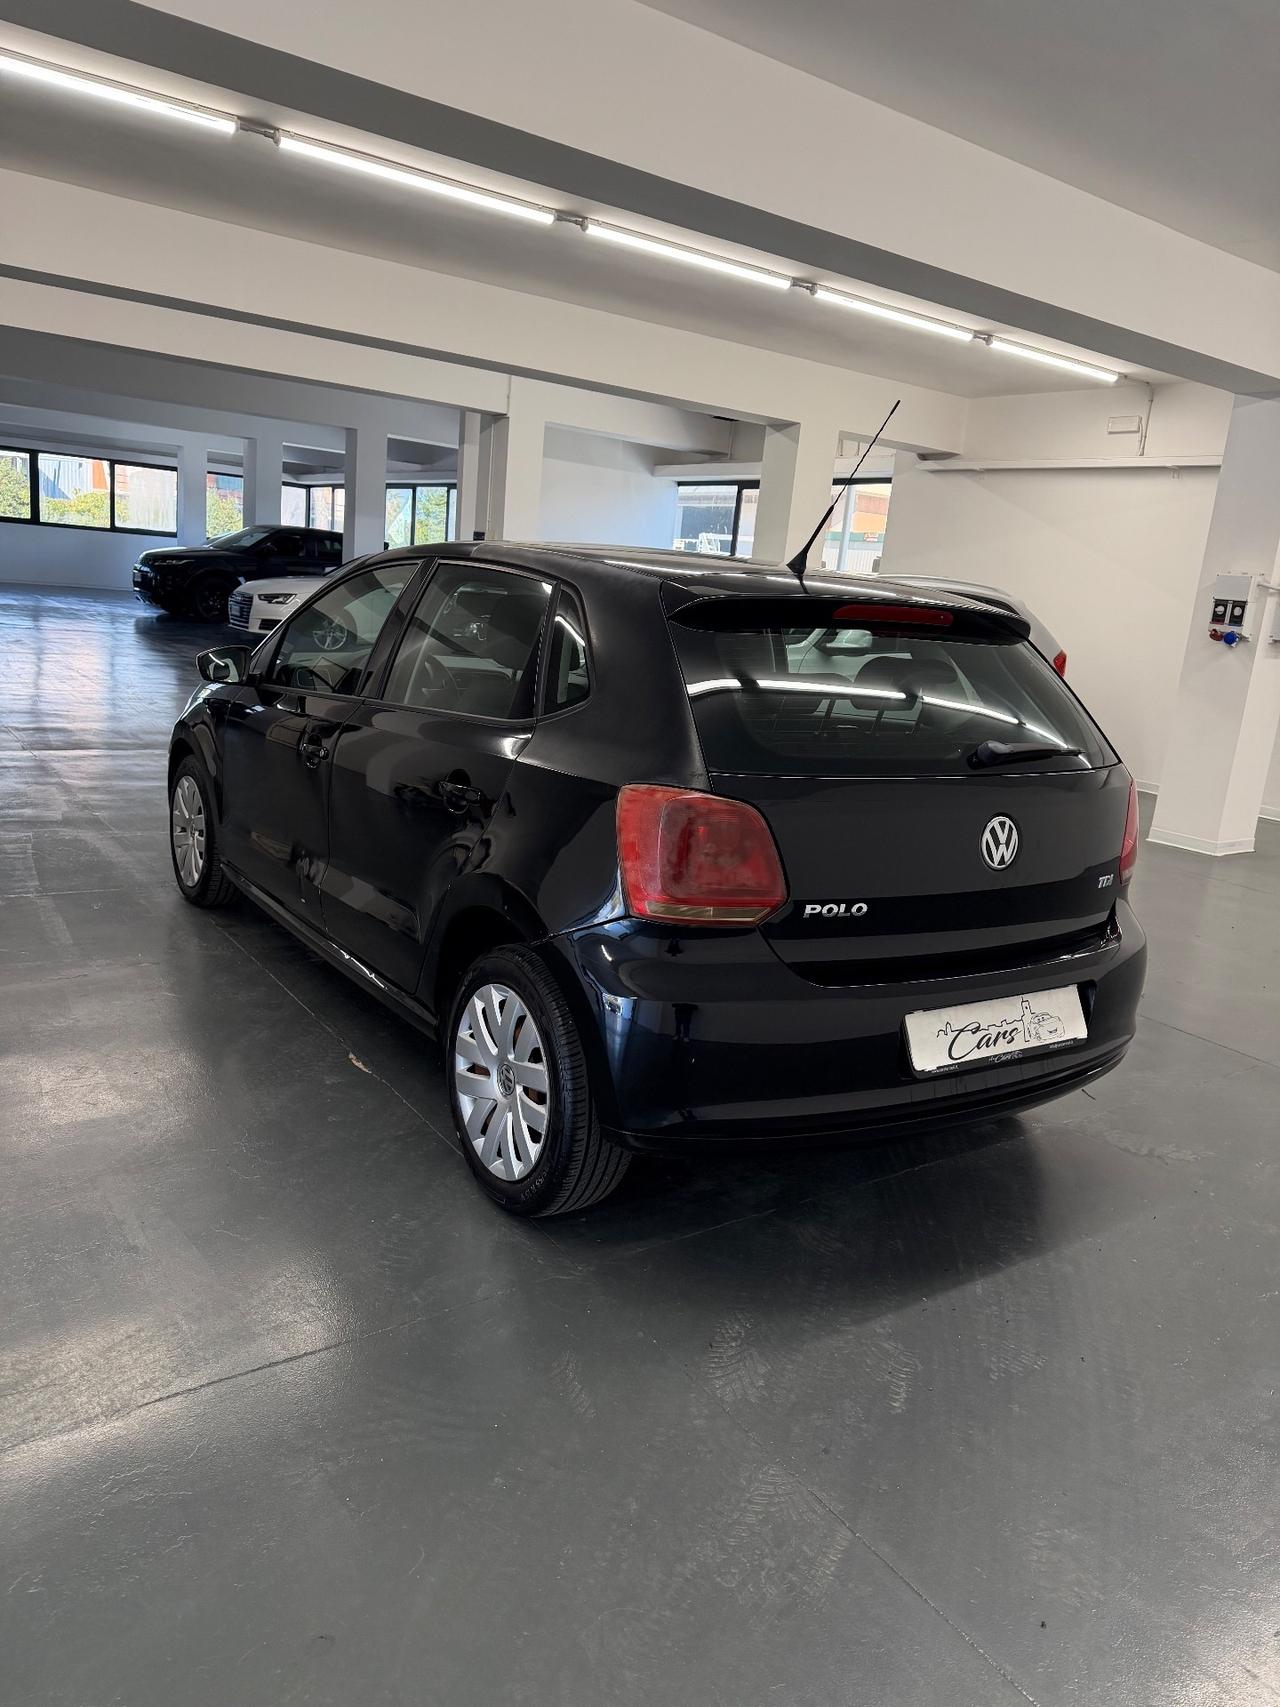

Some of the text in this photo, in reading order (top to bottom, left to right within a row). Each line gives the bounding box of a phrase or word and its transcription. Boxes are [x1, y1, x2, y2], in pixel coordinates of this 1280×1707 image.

[1098, 873, 1114, 889] TDI
[803, 902, 868, 919] POLO
[948, 1021, 1021, 1061] Cars
